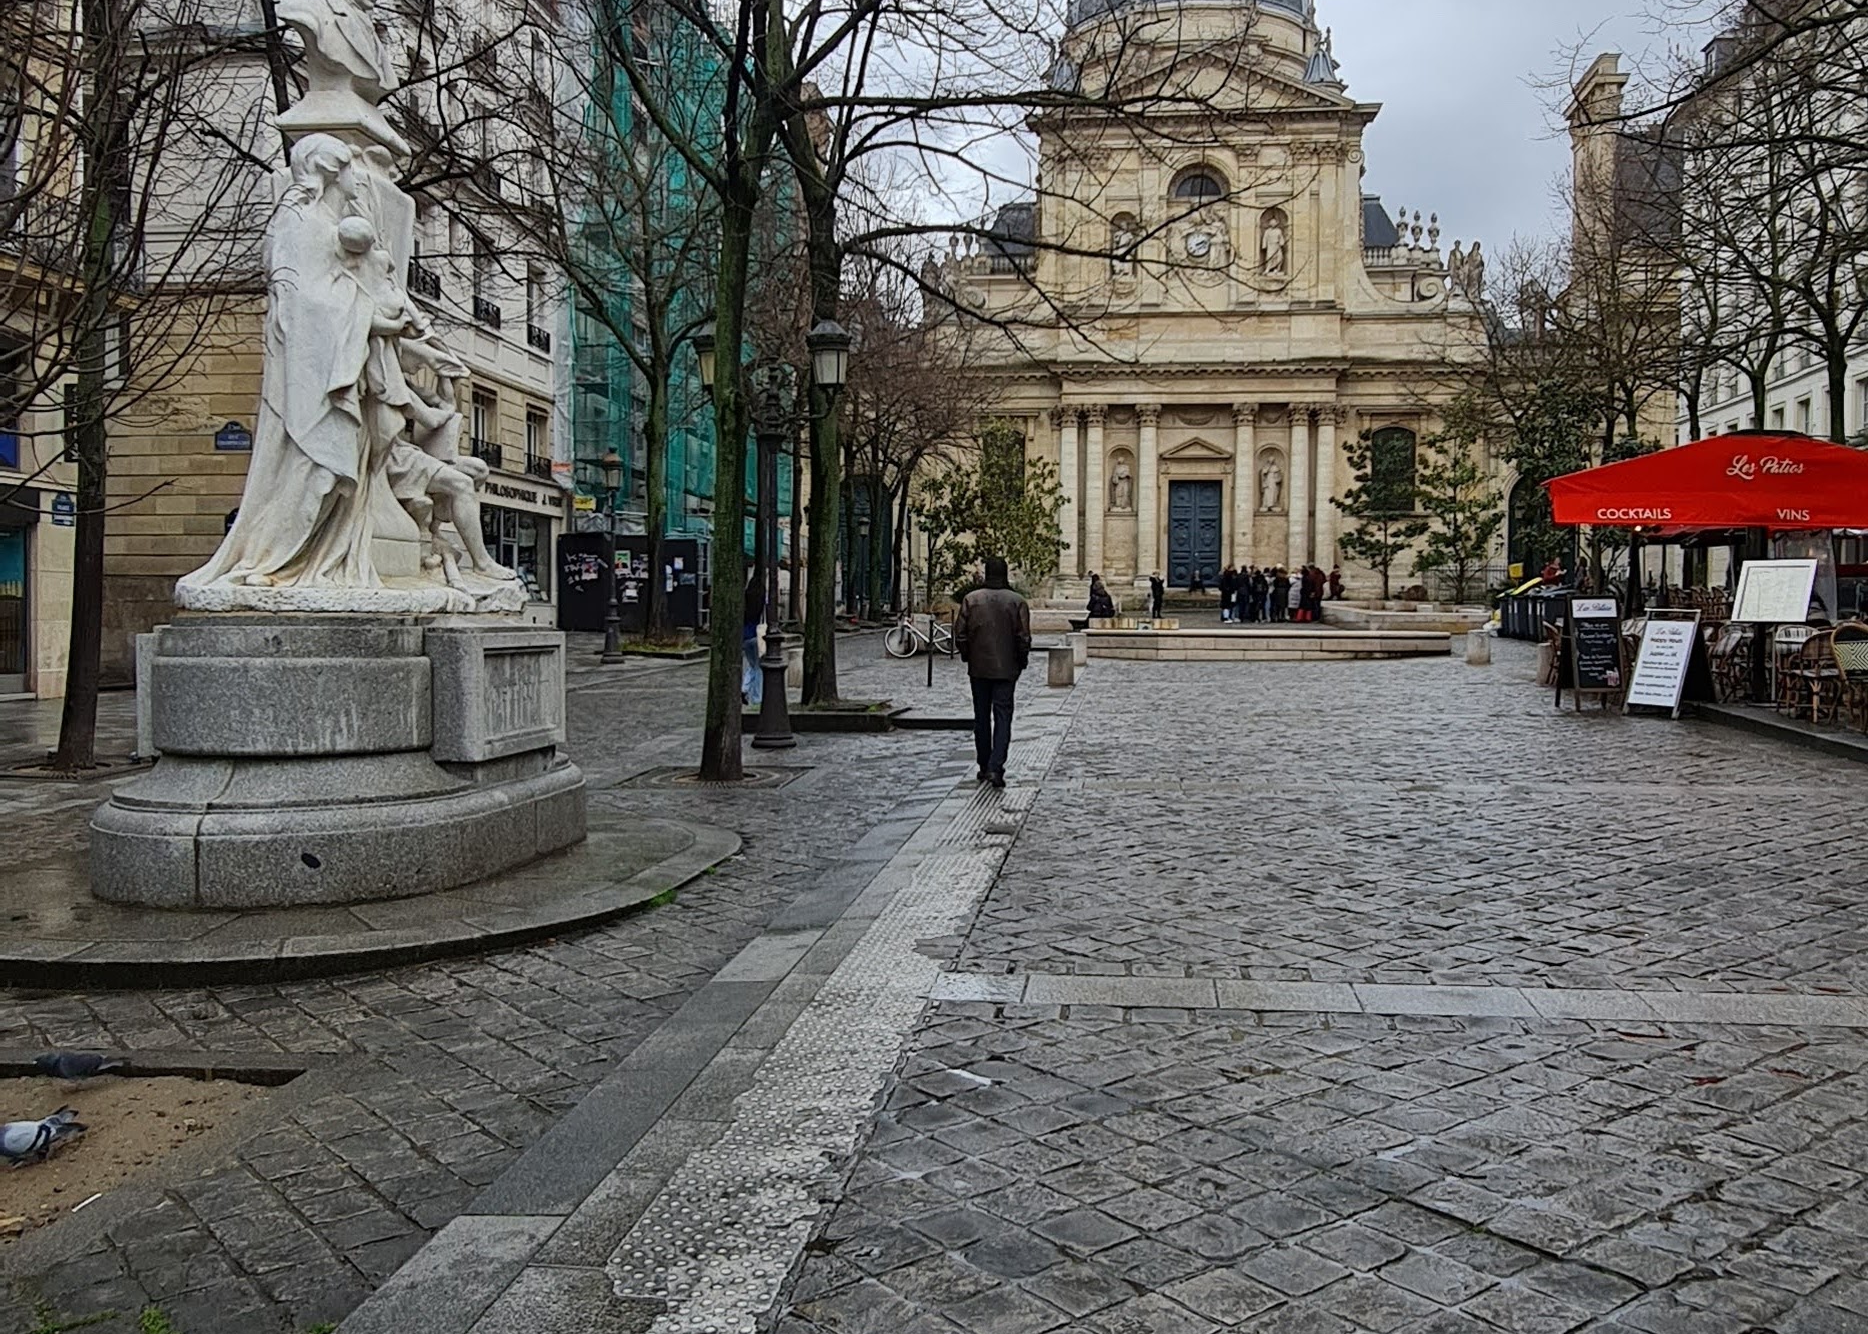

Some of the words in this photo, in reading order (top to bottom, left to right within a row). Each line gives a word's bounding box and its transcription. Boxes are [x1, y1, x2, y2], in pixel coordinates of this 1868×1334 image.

[1726, 454, 1757, 480] Les
[1760, 456, 1806, 474] Patios
[1597, 507, 1672, 519] COCKTAILS
[1776, 508, 1810, 521] VINS
